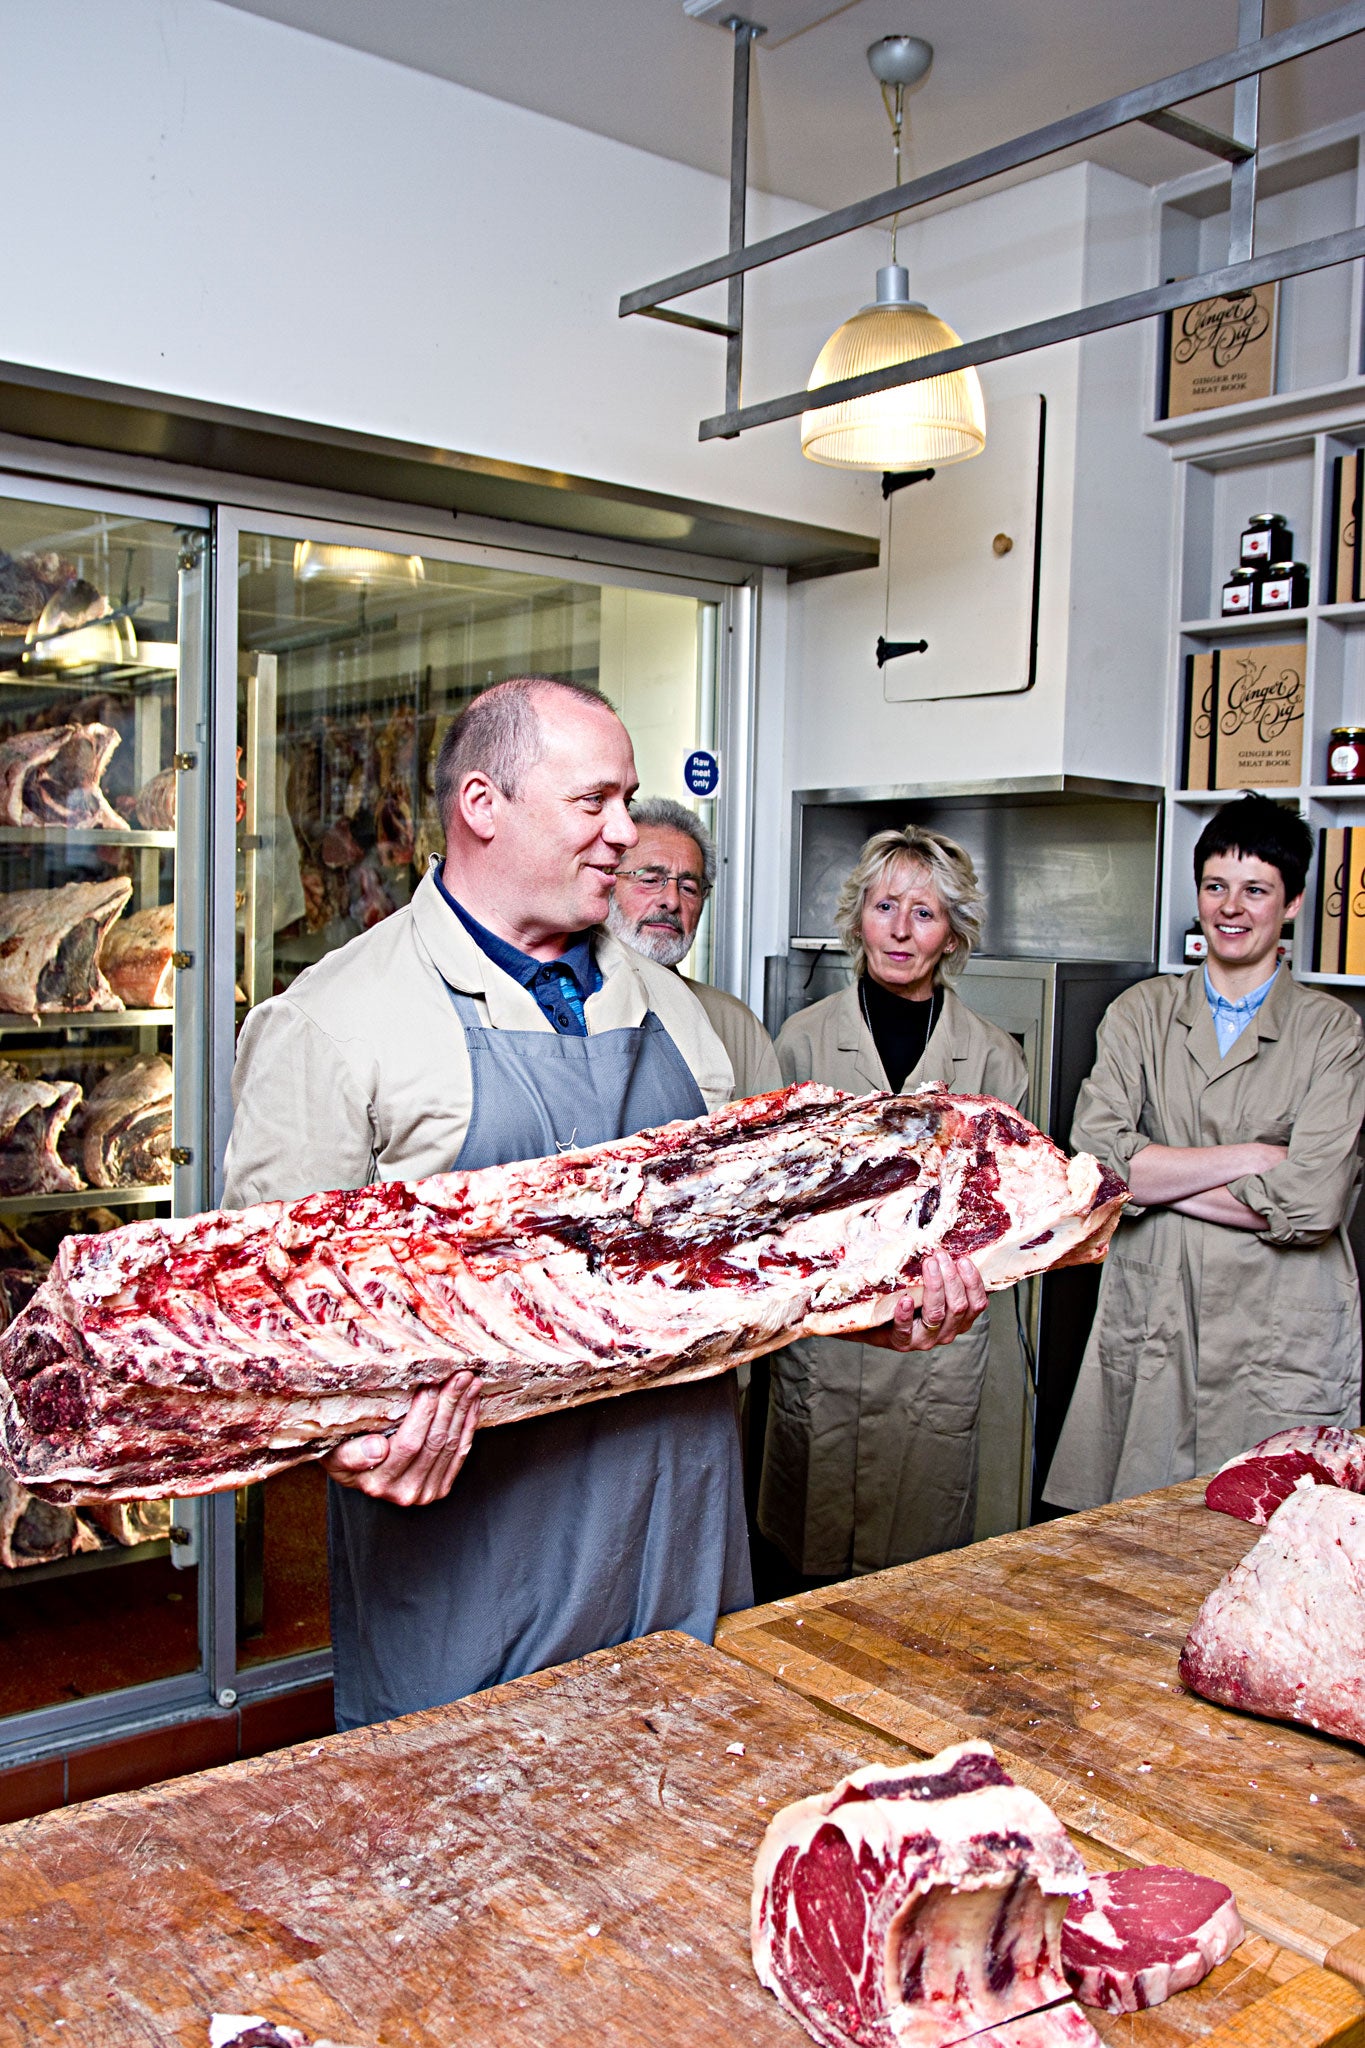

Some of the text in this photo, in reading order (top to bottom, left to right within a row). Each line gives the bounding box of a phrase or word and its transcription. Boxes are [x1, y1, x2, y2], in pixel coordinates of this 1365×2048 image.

[1192, 372, 1248, 385] GINGER PIG
[1192, 382, 1247, 395] MEAT BOOK
[1238, 749, 1291, 758] GINGER PIG
[693, 757, 710, 767] Raw
[1265, 759, 1291, 767] BOOK
[692, 769, 711, 778] meat
[692, 779, 710, 790] only
